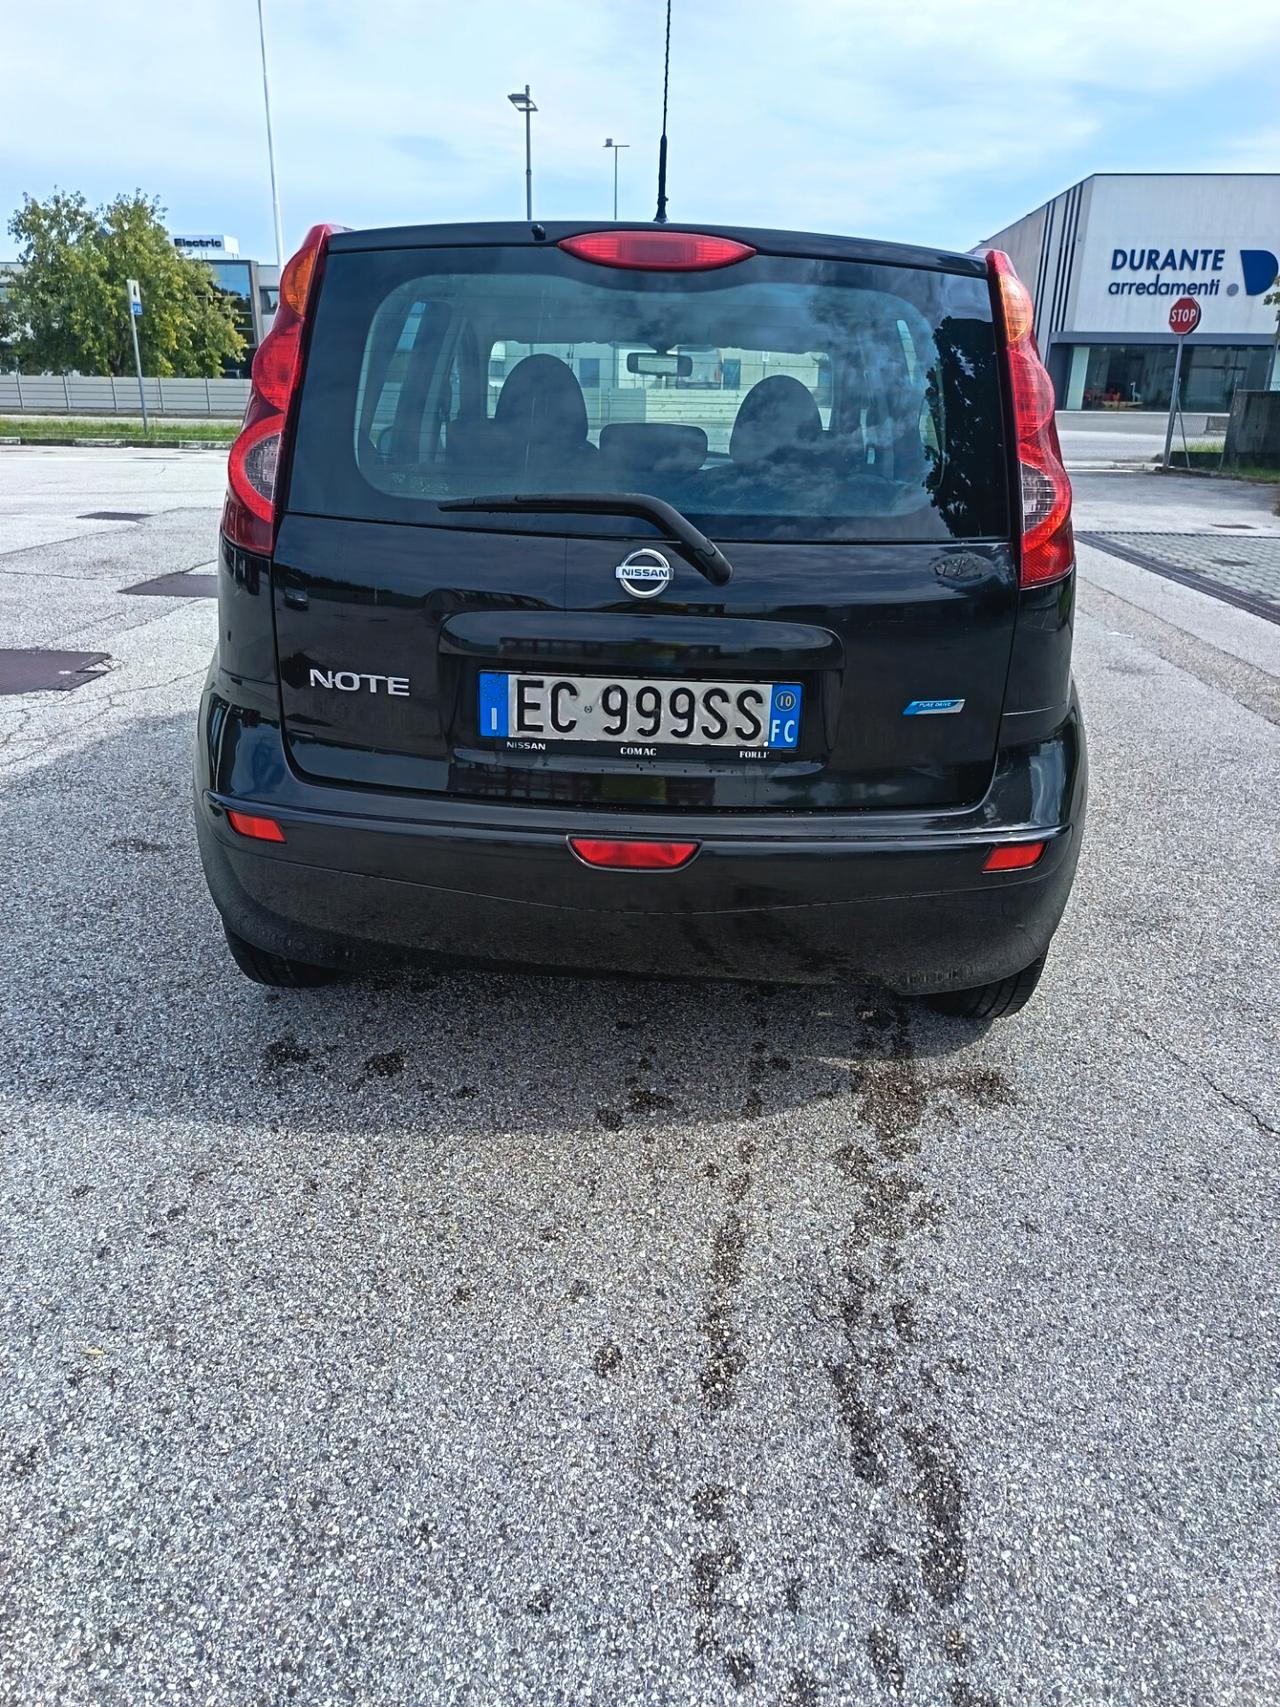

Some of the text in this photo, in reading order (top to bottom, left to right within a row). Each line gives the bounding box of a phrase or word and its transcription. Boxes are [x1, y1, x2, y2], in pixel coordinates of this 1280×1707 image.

[174, 238, 222, 248] Electric
[1111, 249, 1225, 271] DURANTE
[1108, 274, 1220, 296] arredamenti
[1170, 309, 1197, 322] STOP
[621, 568, 667, 577] NISSAN
[309, 669, 410, 696] NOTE
[516, 679, 763, 741] EC 999SS
[771, 719, 795, 743] FC
[506, 741, 546, 750] NISSAN
[620, 747, 657, 756] COMAC
